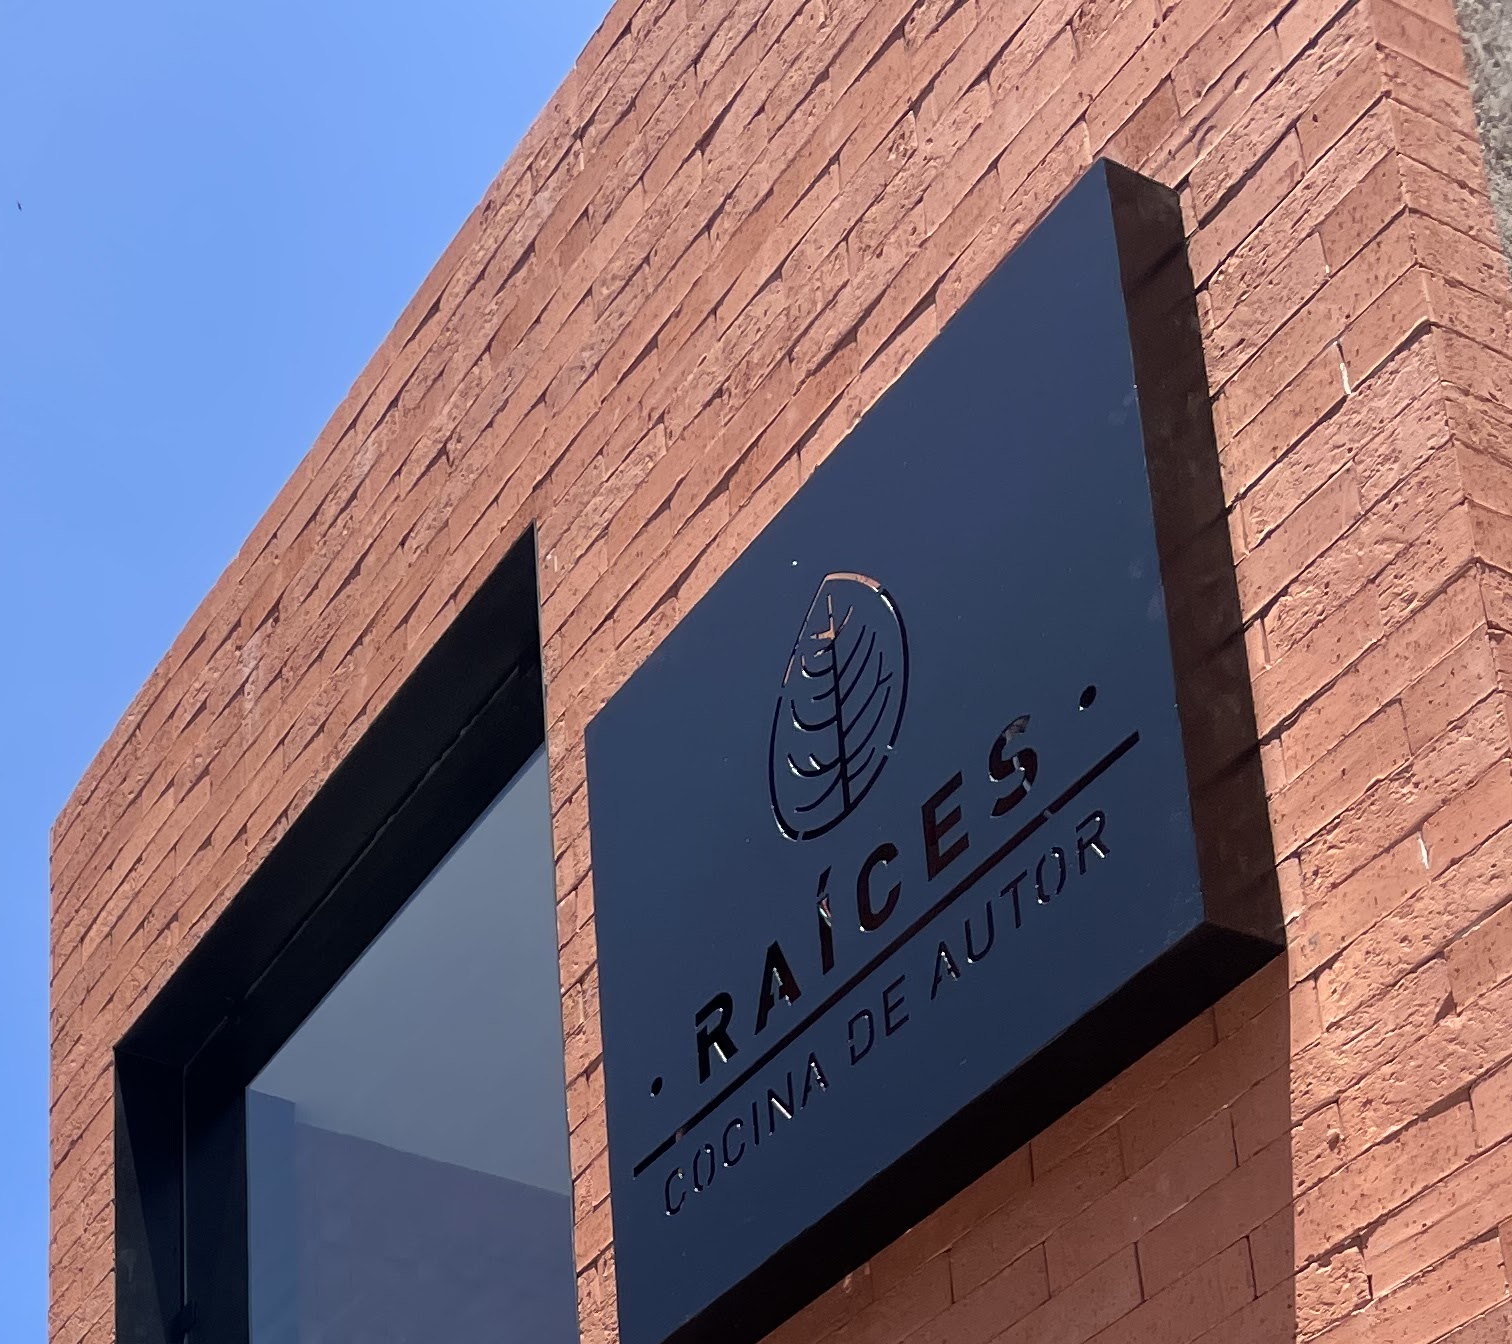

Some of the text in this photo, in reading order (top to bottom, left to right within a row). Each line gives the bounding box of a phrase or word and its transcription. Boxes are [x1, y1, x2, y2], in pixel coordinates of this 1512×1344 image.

[663, 809, 1111, 1216] COCINA DE AUTOR
[694, 714, 1039, 1085] RAÍCES
